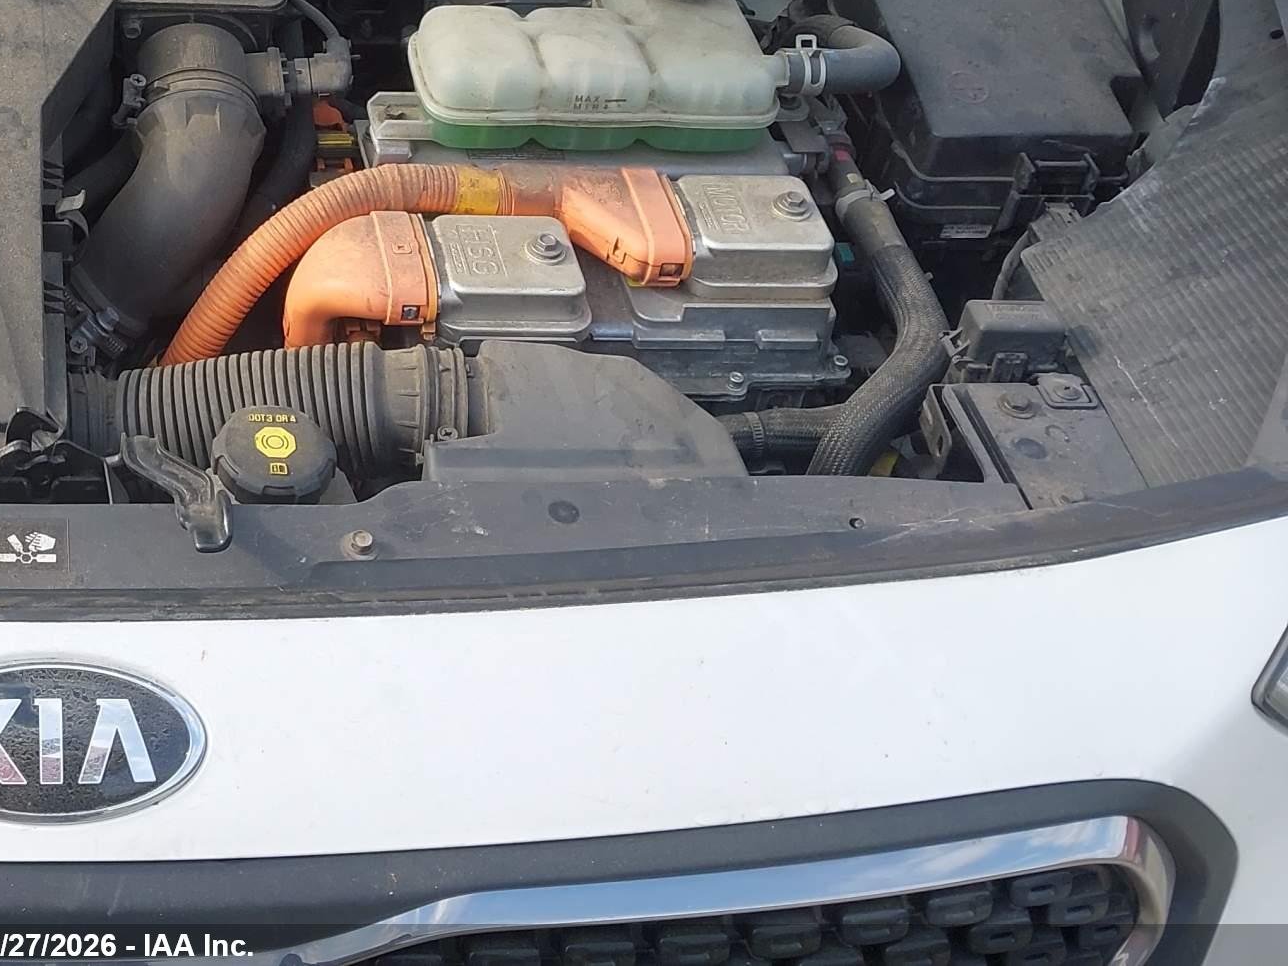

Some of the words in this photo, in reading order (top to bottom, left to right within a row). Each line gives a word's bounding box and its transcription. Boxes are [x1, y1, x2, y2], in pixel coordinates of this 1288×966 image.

[705, 185, 751, 233] MOTOR
[275, 414, 289, 423] OR
[289, 414, 297, 423] 4
